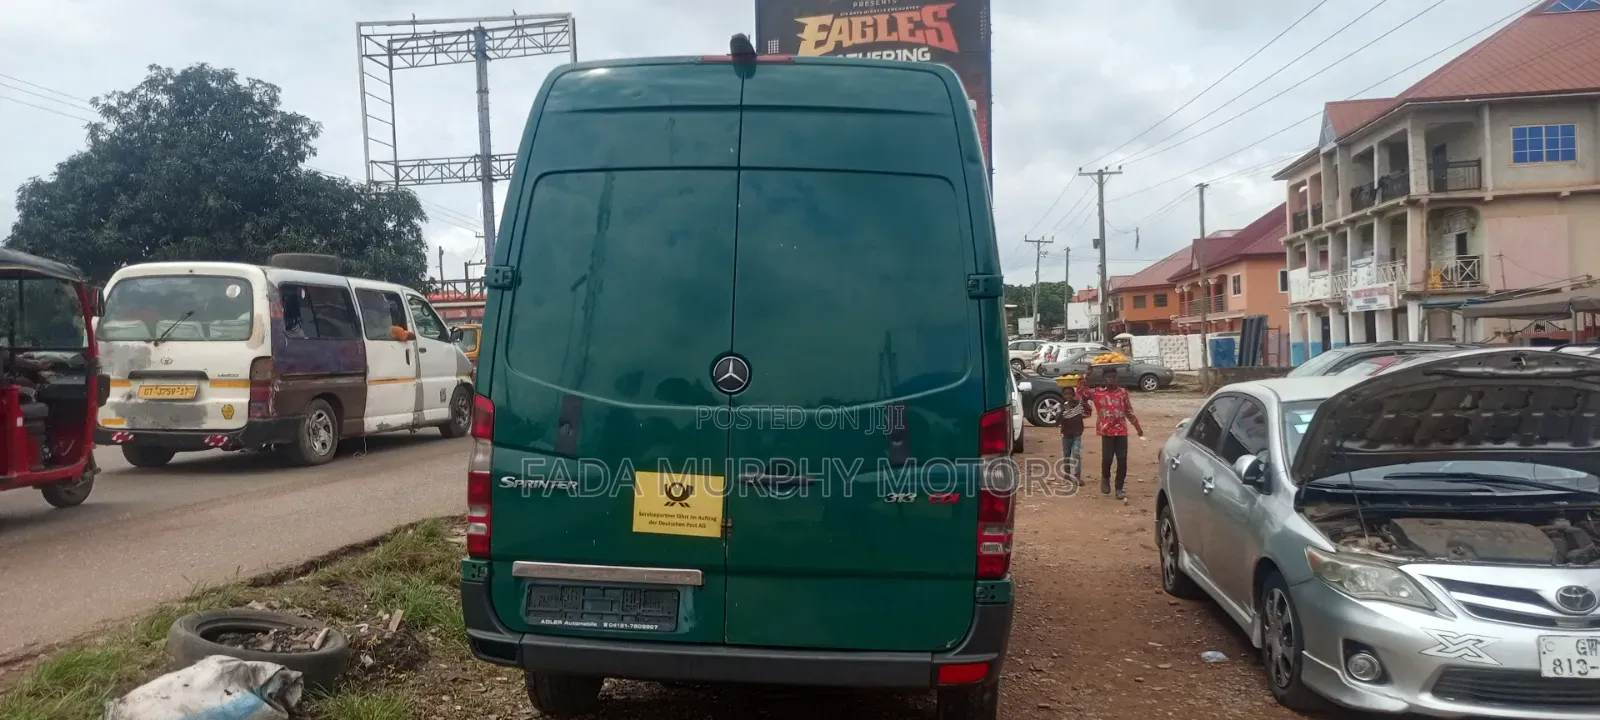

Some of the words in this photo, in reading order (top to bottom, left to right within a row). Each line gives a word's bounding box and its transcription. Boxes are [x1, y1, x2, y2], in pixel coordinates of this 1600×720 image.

[794, 2, 959, 57] EAGLES
[884, 492, 917, 503] 313
[638, 511, 676, 520] Servicepartner
